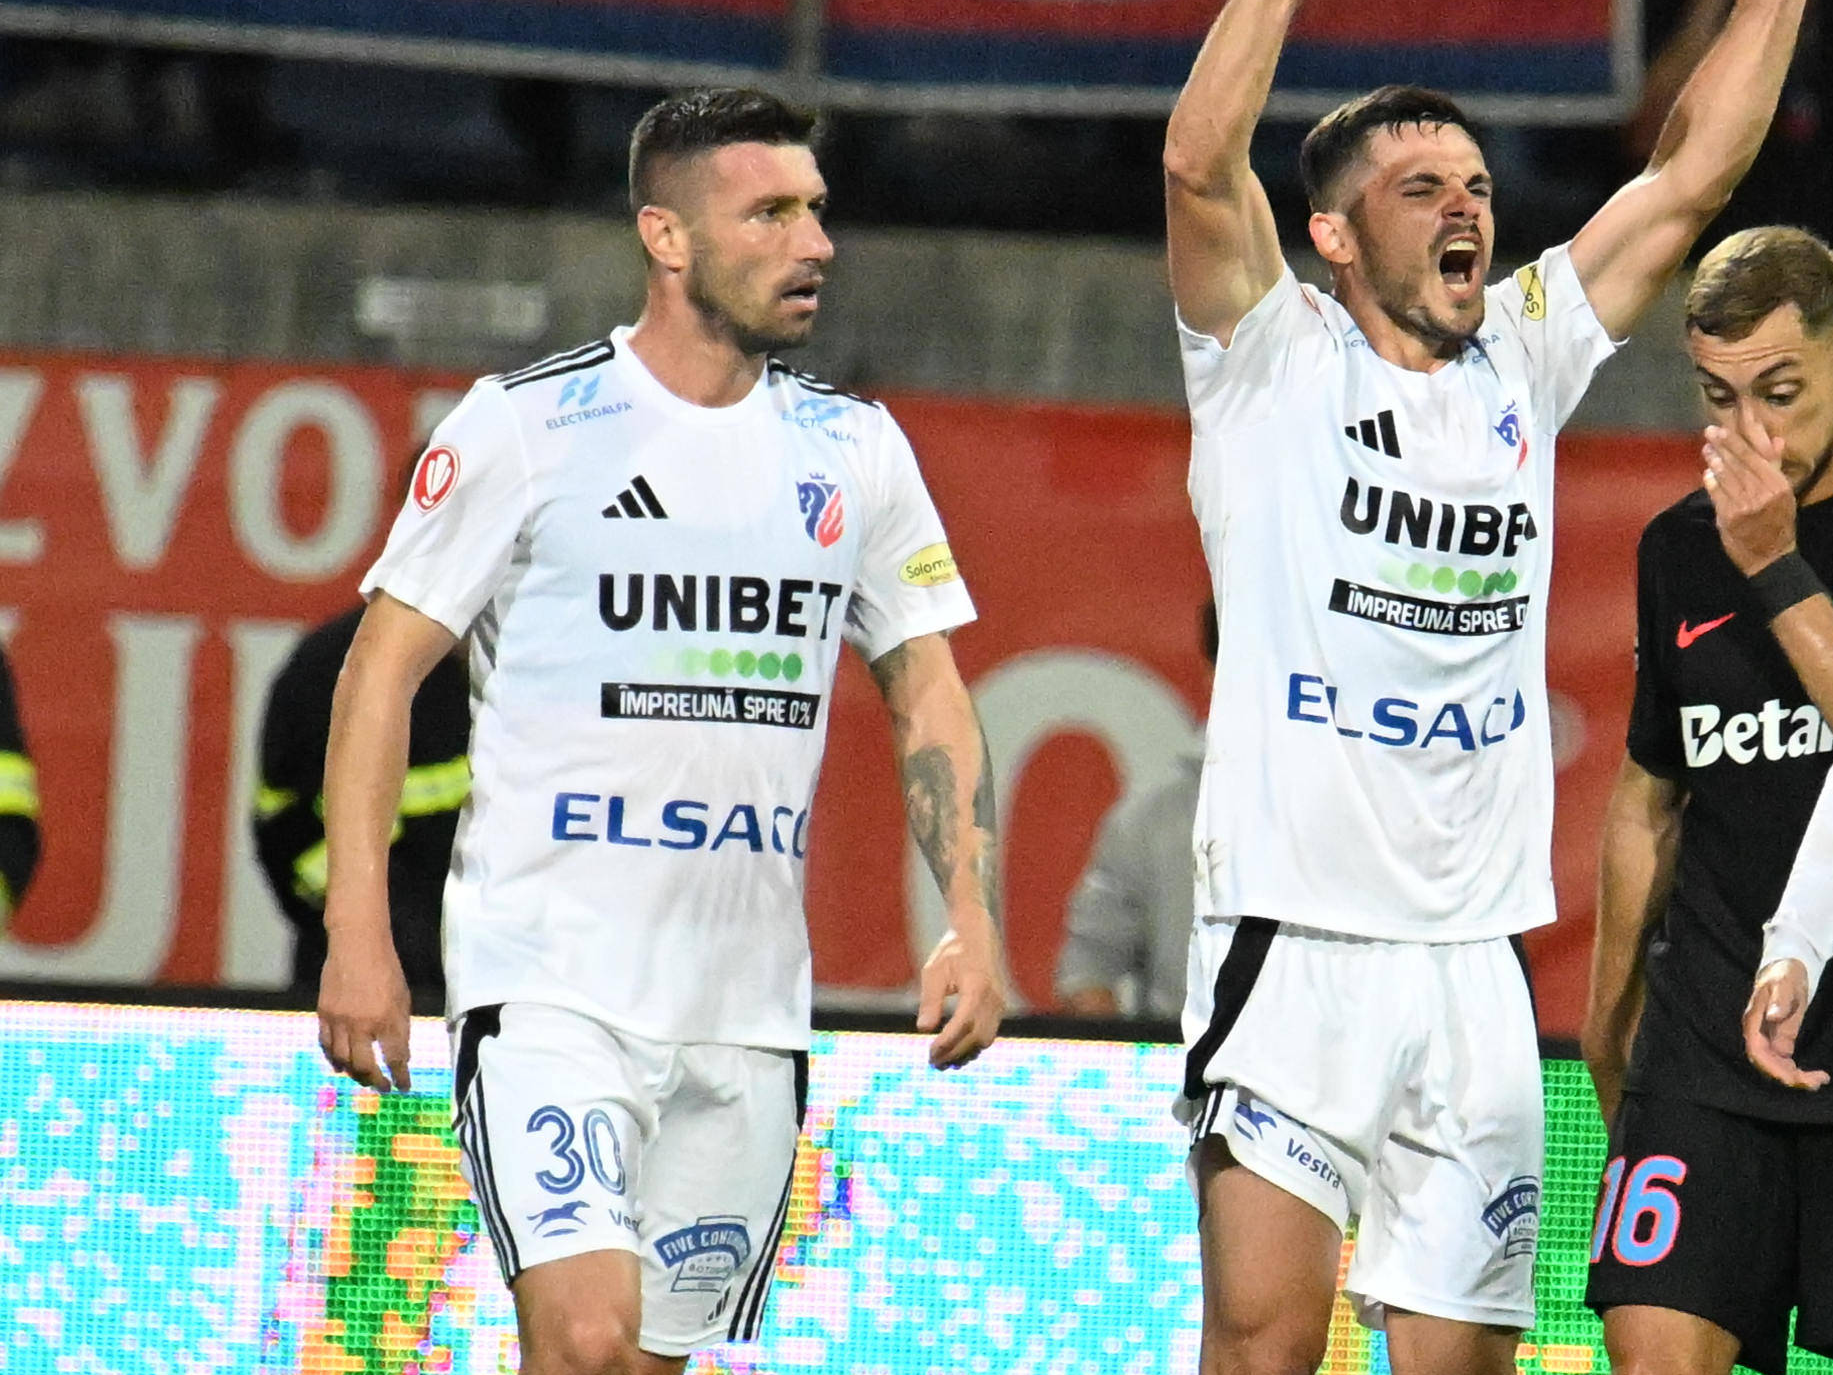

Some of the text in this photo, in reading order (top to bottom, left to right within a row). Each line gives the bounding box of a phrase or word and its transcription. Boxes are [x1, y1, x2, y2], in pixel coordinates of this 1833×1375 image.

[598, 572, 843, 641] UNIBET
[1458, 607, 1510, 634] SPRE
[618, 684, 812, 726] ÎMPREUNĂ SPRE 0%
[526, 1104, 626, 1196] 30
[1286, 1137, 1342, 1190] Vestra
[1590, 1154, 1688, 1267] 16
